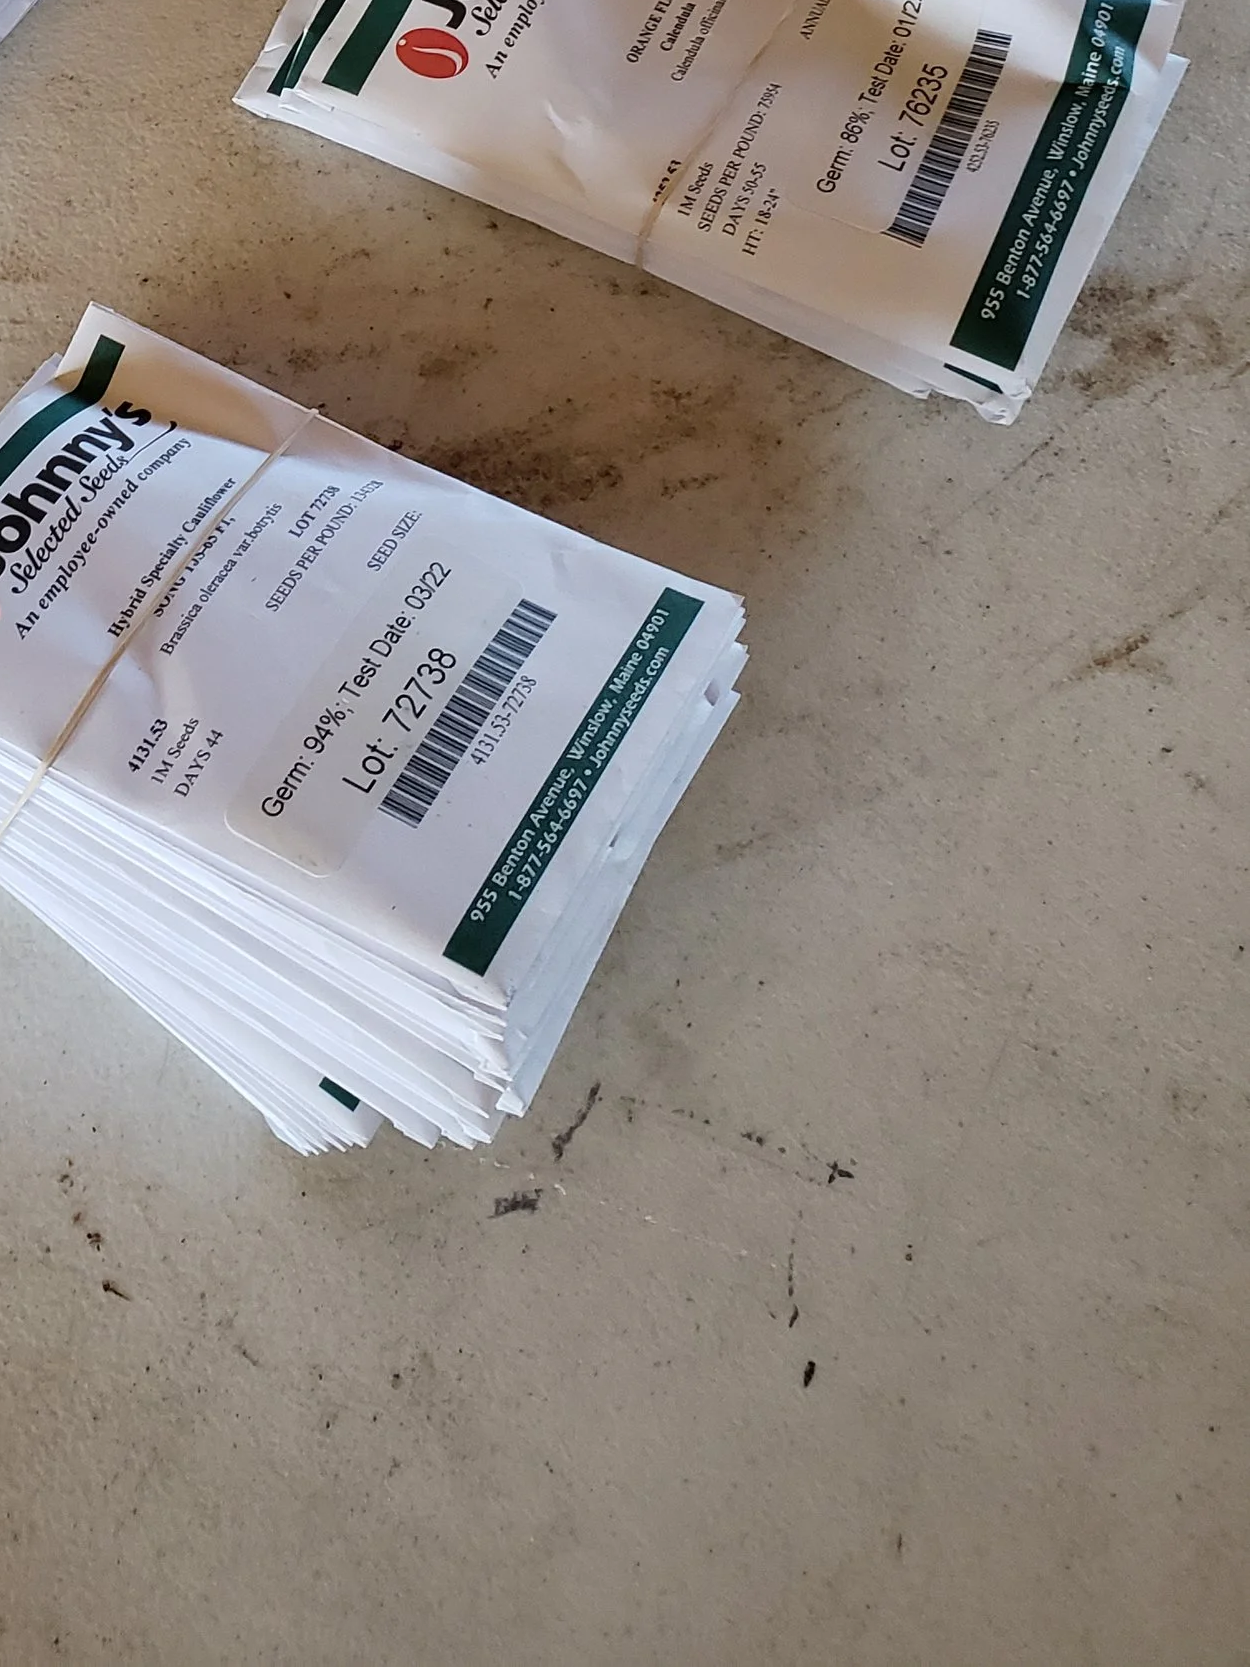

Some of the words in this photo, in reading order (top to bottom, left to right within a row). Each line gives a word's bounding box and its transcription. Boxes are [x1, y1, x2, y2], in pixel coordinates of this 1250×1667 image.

[624, 13, 663, 64] ORANGE
[658, 0, 697, 53] Calendula
[669, 34, 706, 83] Calendula
[1089, 0, 1115, 49] 04901
[895, 60, 951, 129] 76235
[1070, 49, 1107, 98] Maine
[813, 143, 856, 196] Germ:
[837, 103, 875, 145] 86%;
[857, 73, 890, 107] Test
[874, 38, 907, 76] Date:
[875, 127, 919, 173] Lot:
[1044, 96, 1089, 164] Winslow,
[1018, 163, 1061, 228] Avenue,
[992, 225, 1033, 286] Benton
[979, 286, 1007, 321] 955
[9, 494, 84, 593] Selected
[78, 453, 129, 504] Seeds
[16, 610, 41, 640] An
[34, 479, 141, 611] employee-owned
[134, 436, 192, 481] company
[103, 586, 152, 638] Hybrid
[138, 531, 193, 590] Specialty
[179, 473, 238, 537] Cauliflower
[157, 601, 206, 657] Brassica
[195, 556, 240, 605] oleracea
[230, 500, 285, 561] var.botrytis
[257, 752, 317, 820] Germ:
[300, 698, 355, 757] 94%;
[337, 654, 383, 703] Test
[368, 607, 417, 659] Date:
[402, 559, 452, 612] 03/22
[340, 733, 400, 795] Lot:
[381, 644, 459, 735] 72738
[467, 673, 538, 767] 4131.53-72738
[122, 717, 172, 774] 4131.53
[467, 887, 499, 924] 955
[489, 826, 536, 887] Benton
[526, 762, 576, 828] Avenue,
[566, 693, 618, 764] Winslow,
[607, 649, 645, 694] Maine
[633, 606, 670, 651] 04901
